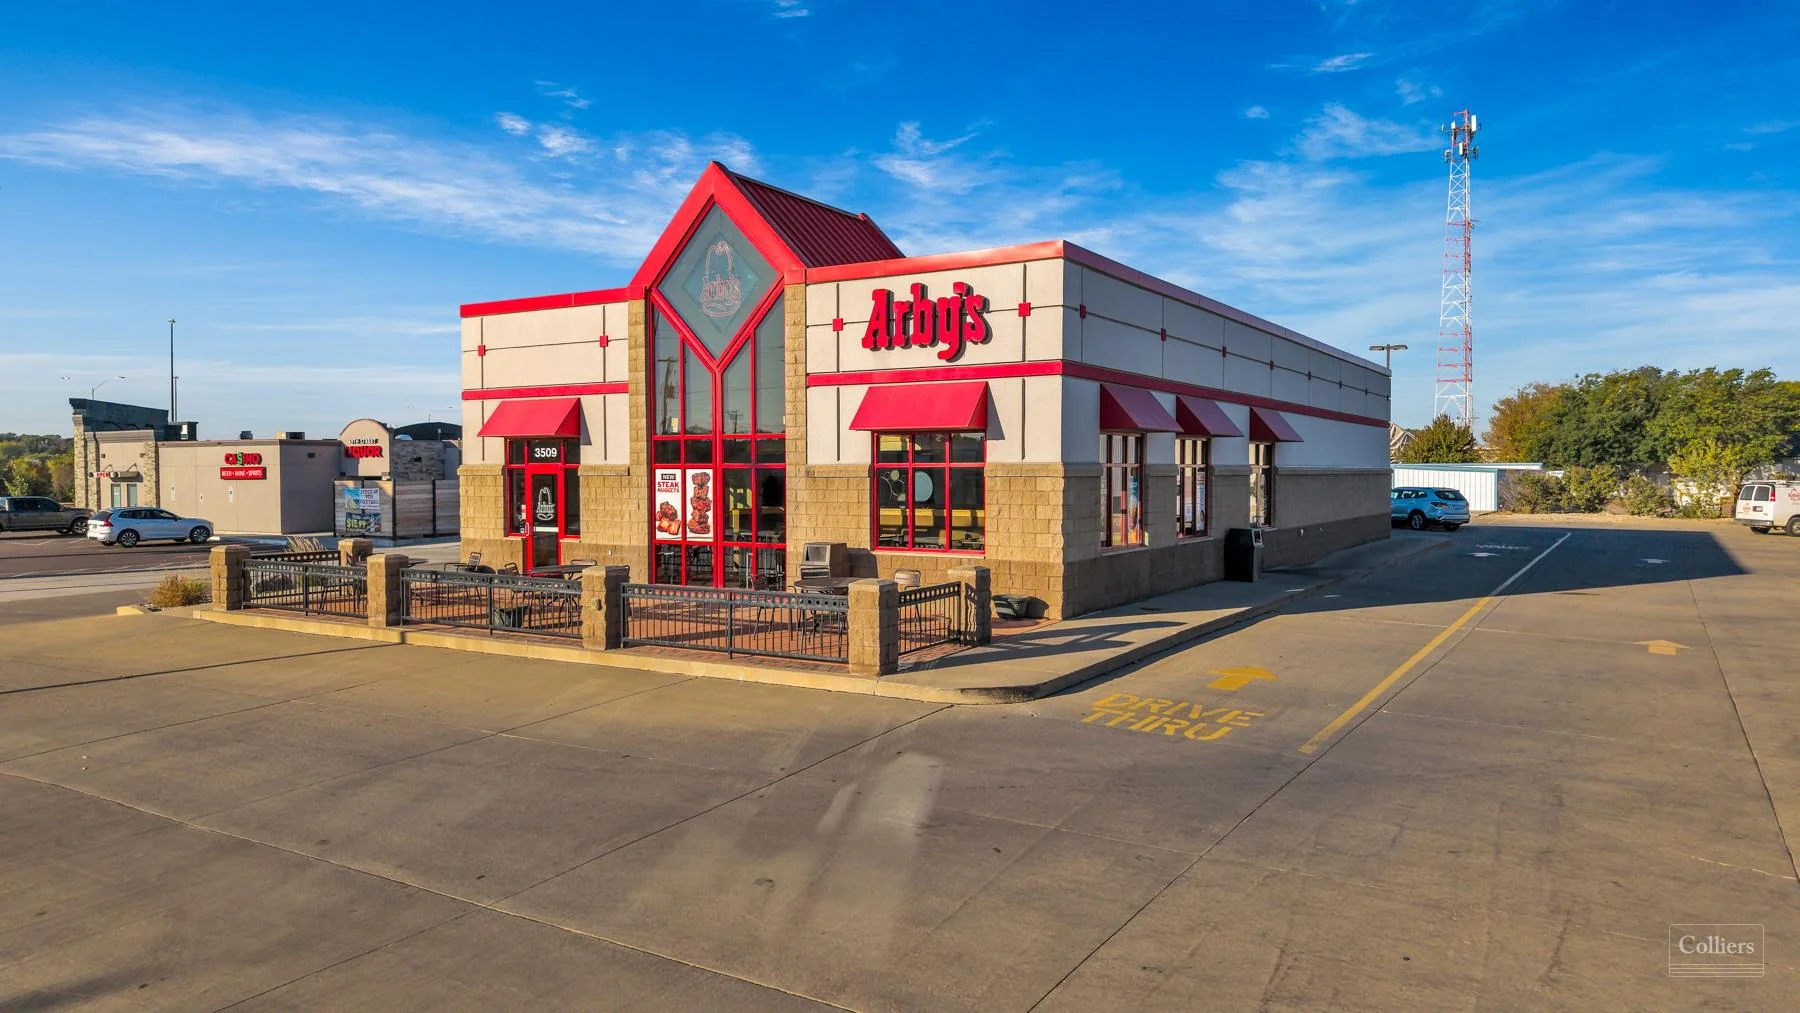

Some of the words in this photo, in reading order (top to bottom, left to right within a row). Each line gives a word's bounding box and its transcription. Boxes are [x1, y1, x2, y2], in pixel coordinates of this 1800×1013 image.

[862, 281, 990, 361] Arby's
[344, 445, 383, 458] LIQUOR
[534, 447, 557, 458] 3509
[225, 452, 262, 465] CASINO
[346, 518, 367, 529] $15.99
[1092, 692, 1265, 727] DRIVE
[1081, 706, 1232, 741] THRU
